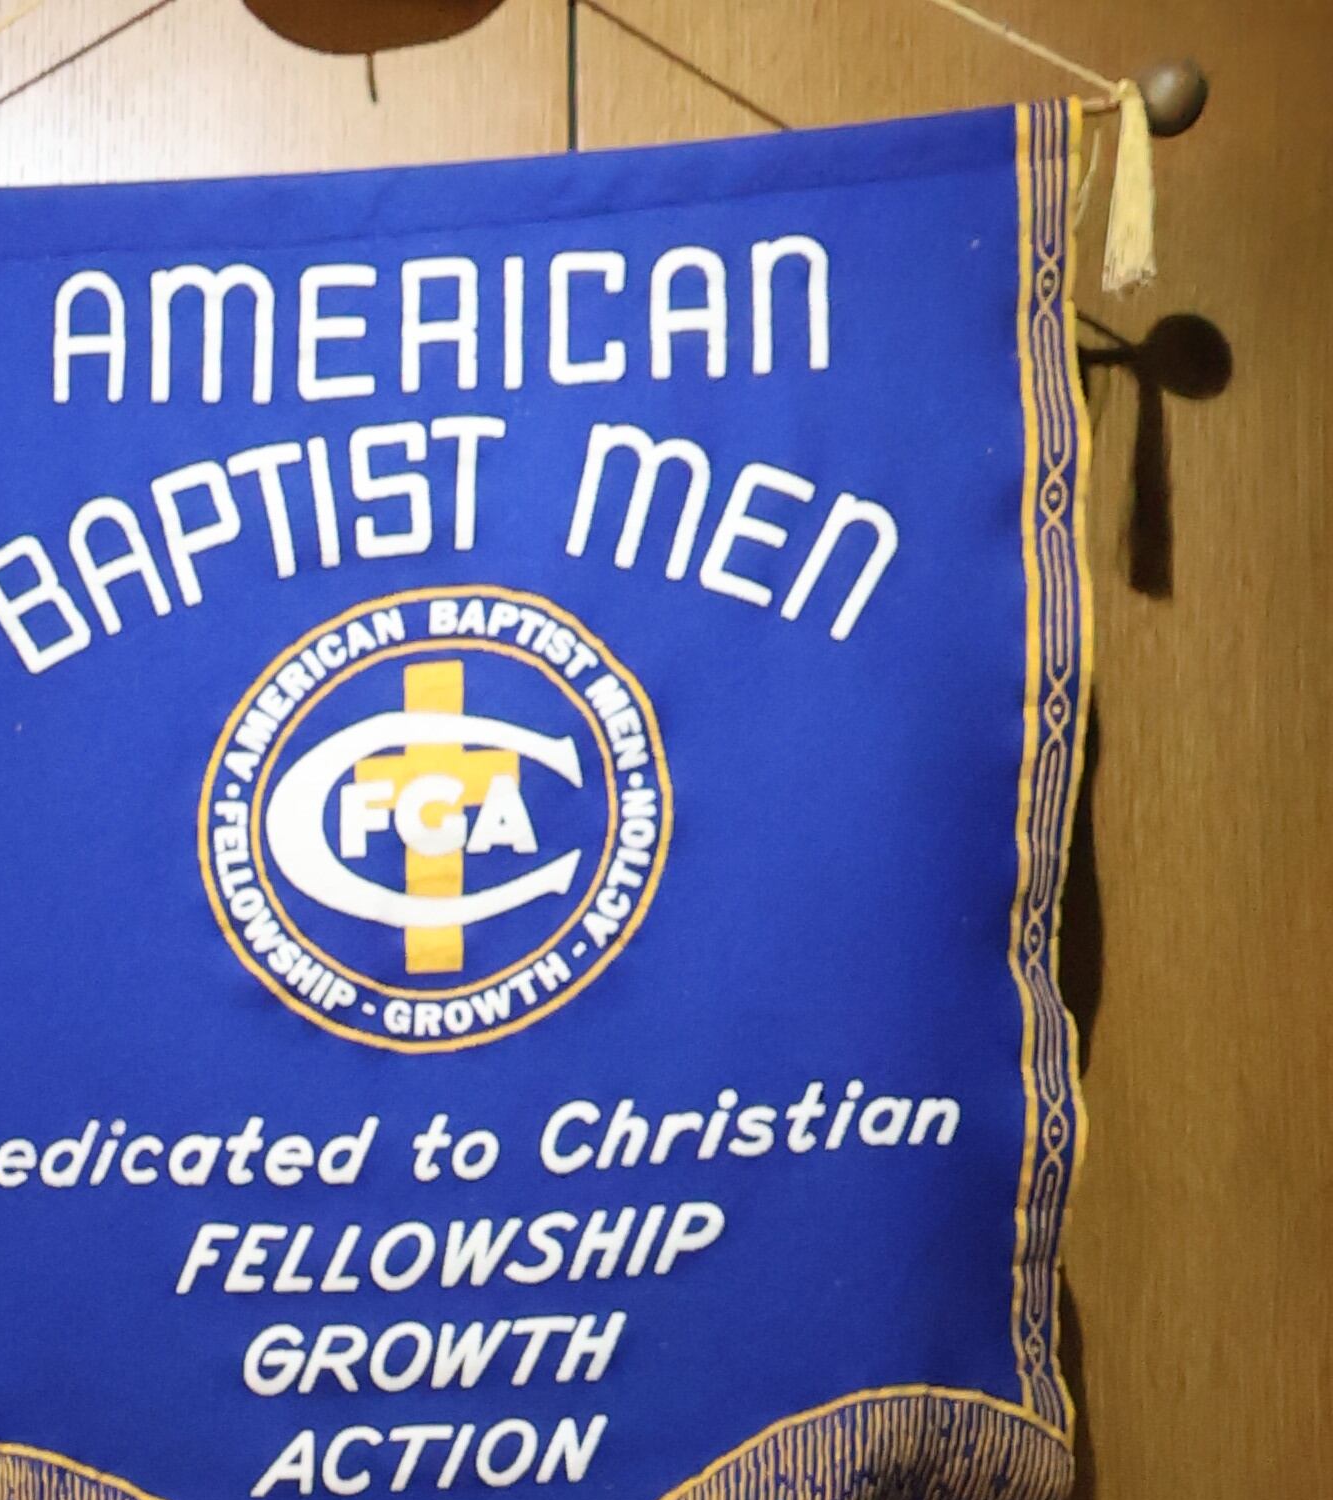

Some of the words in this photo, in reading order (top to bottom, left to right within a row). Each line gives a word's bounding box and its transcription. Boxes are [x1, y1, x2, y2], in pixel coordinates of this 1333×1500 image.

[51, 233, 831, 406] AMERICAN
[563, 421, 900, 642] MEN
[225, 607, 406, 783] AMERICAN
[429, 599, 598, 678] BAPTIST
[584, 674, 649, 771] MEN
[339, 773, 539, 858] FGA
[213, 800, 358, 1013] FELLOWSHIP
[382, 951, 572, 1036] GROWTH
[581, 784, 657, 949] ACTION
[411, 1112, 501, 1184] to
[538, 1077, 962, 1176] Christian
[174, 1200, 727, 1296] FELLOWSHIP
[241, 1309, 629, 1398] GROWTH
[248, 1412, 610, 1499] ACTION
